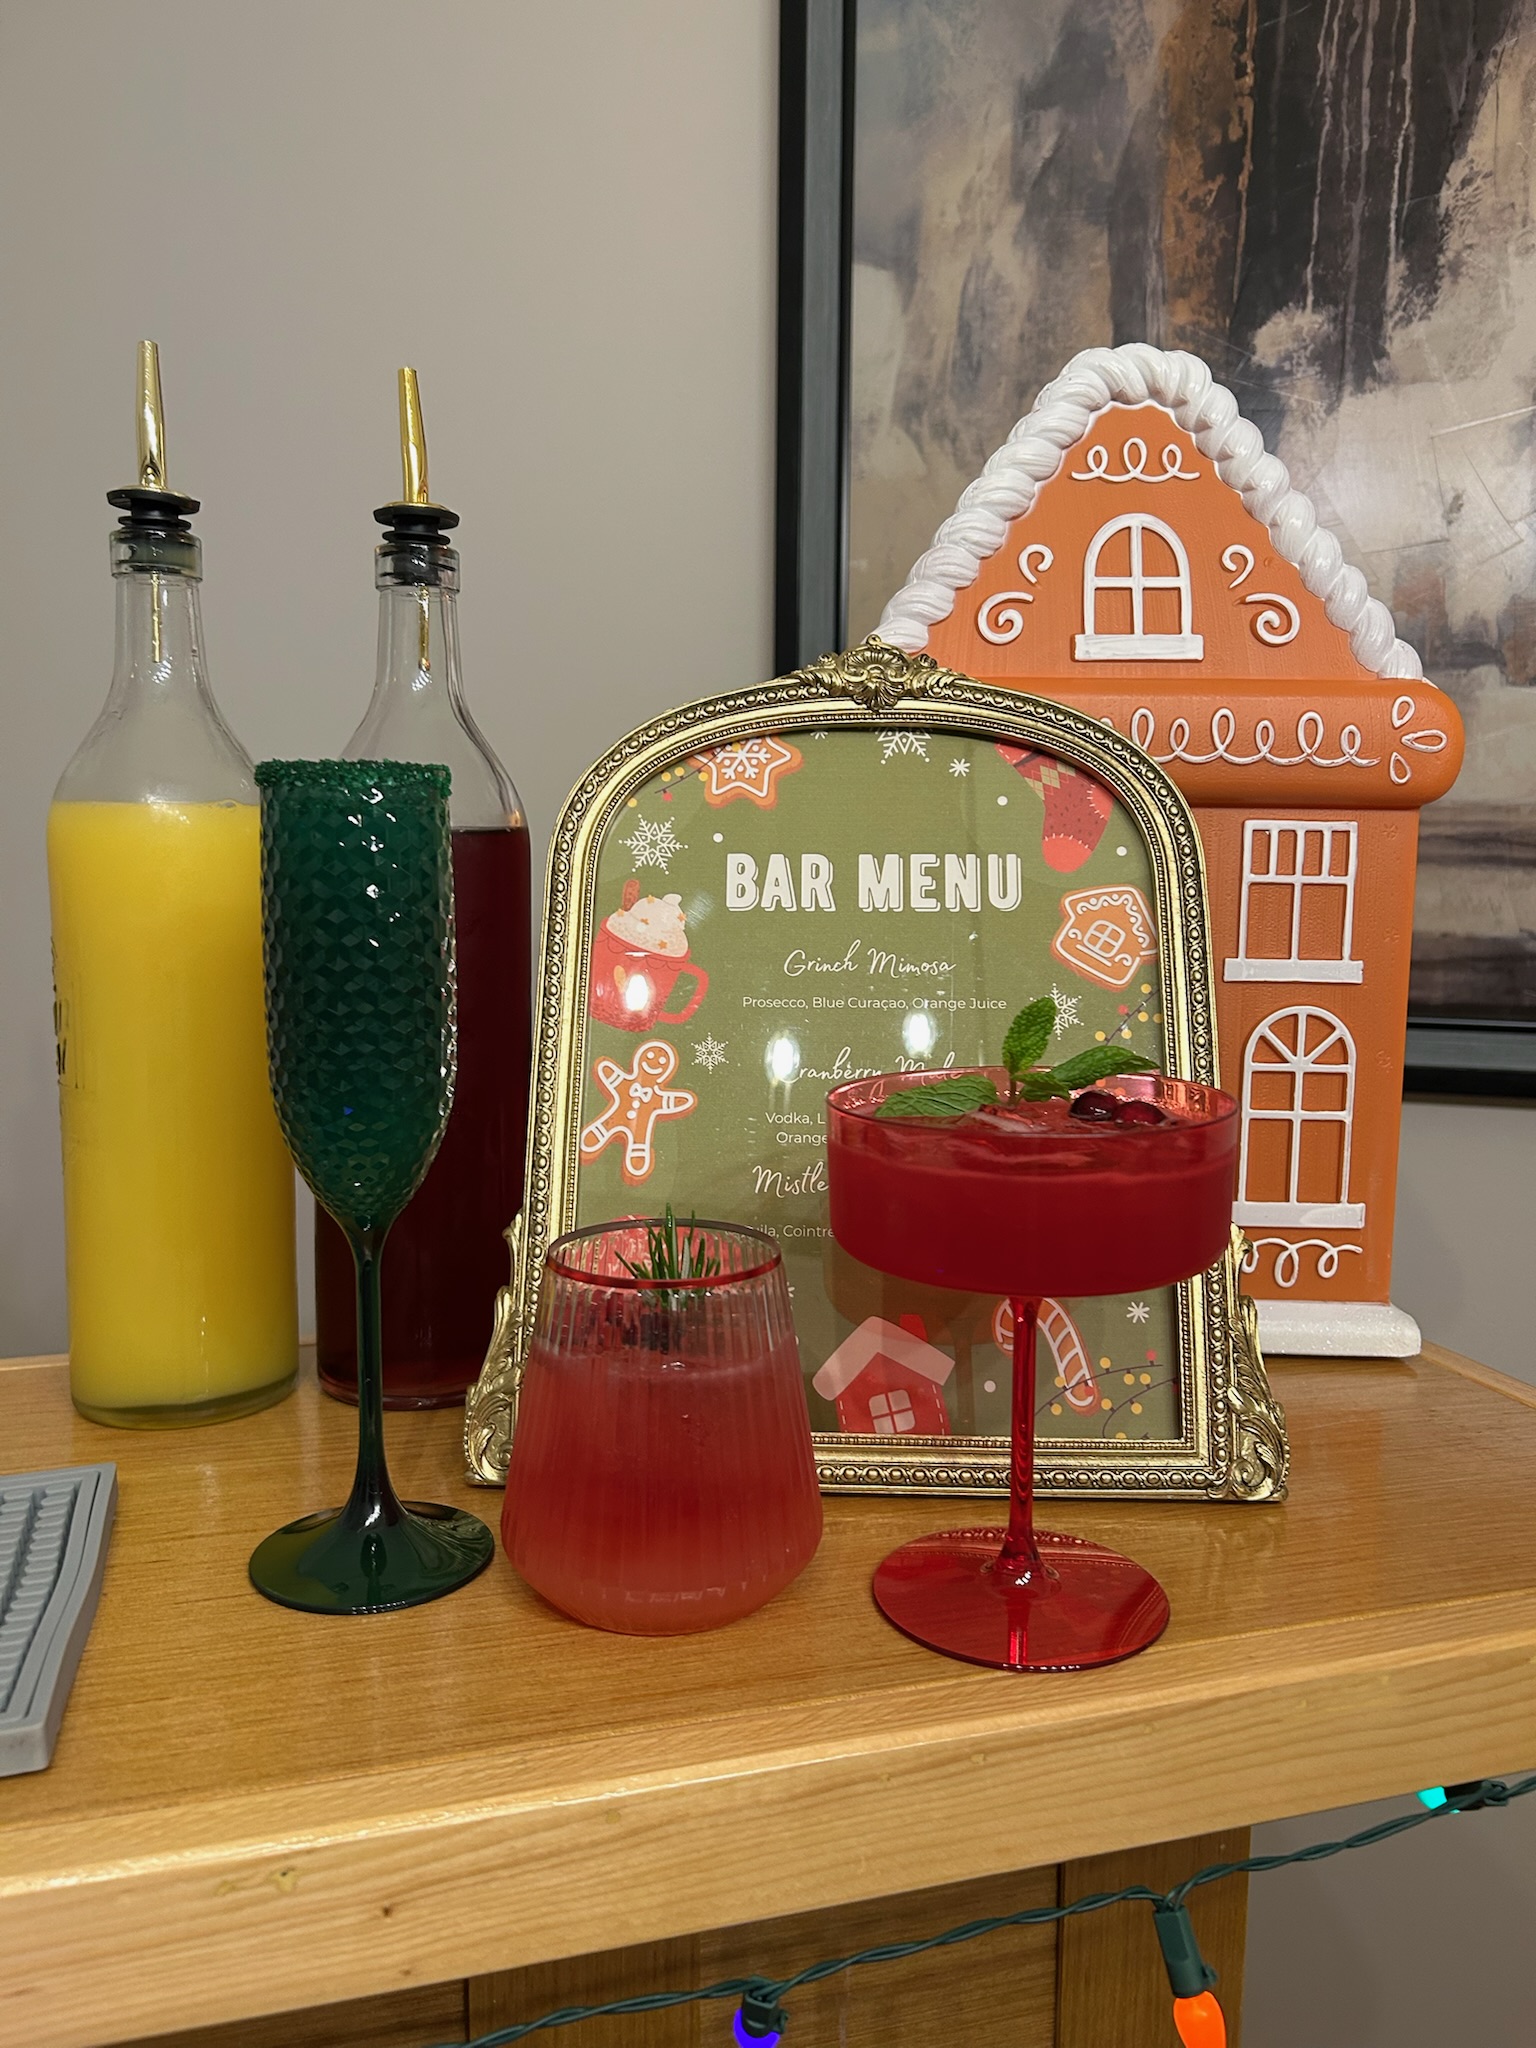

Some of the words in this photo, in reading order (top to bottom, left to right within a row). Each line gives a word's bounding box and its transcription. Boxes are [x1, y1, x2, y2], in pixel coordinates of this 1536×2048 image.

[726, 853, 836, 912] BAR
[858, 853, 1022, 912] MENU
[783, 939, 861, 977] Grinch
[867, 948, 957, 978] Mimosa
[742, 996, 809, 1010] Prosecco,
[812, 996, 845, 1009] Blue
[848, 996, 909, 1011] Curaçao,
[912, 996, 966, 1011] Orange
[969, 997, 1008, 1010] Juice
[779, 1046, 884, 1098] ranberry
[765, 1112, 813, 1126] Vodka,
[776, 1131, 828, 1145] Orange
